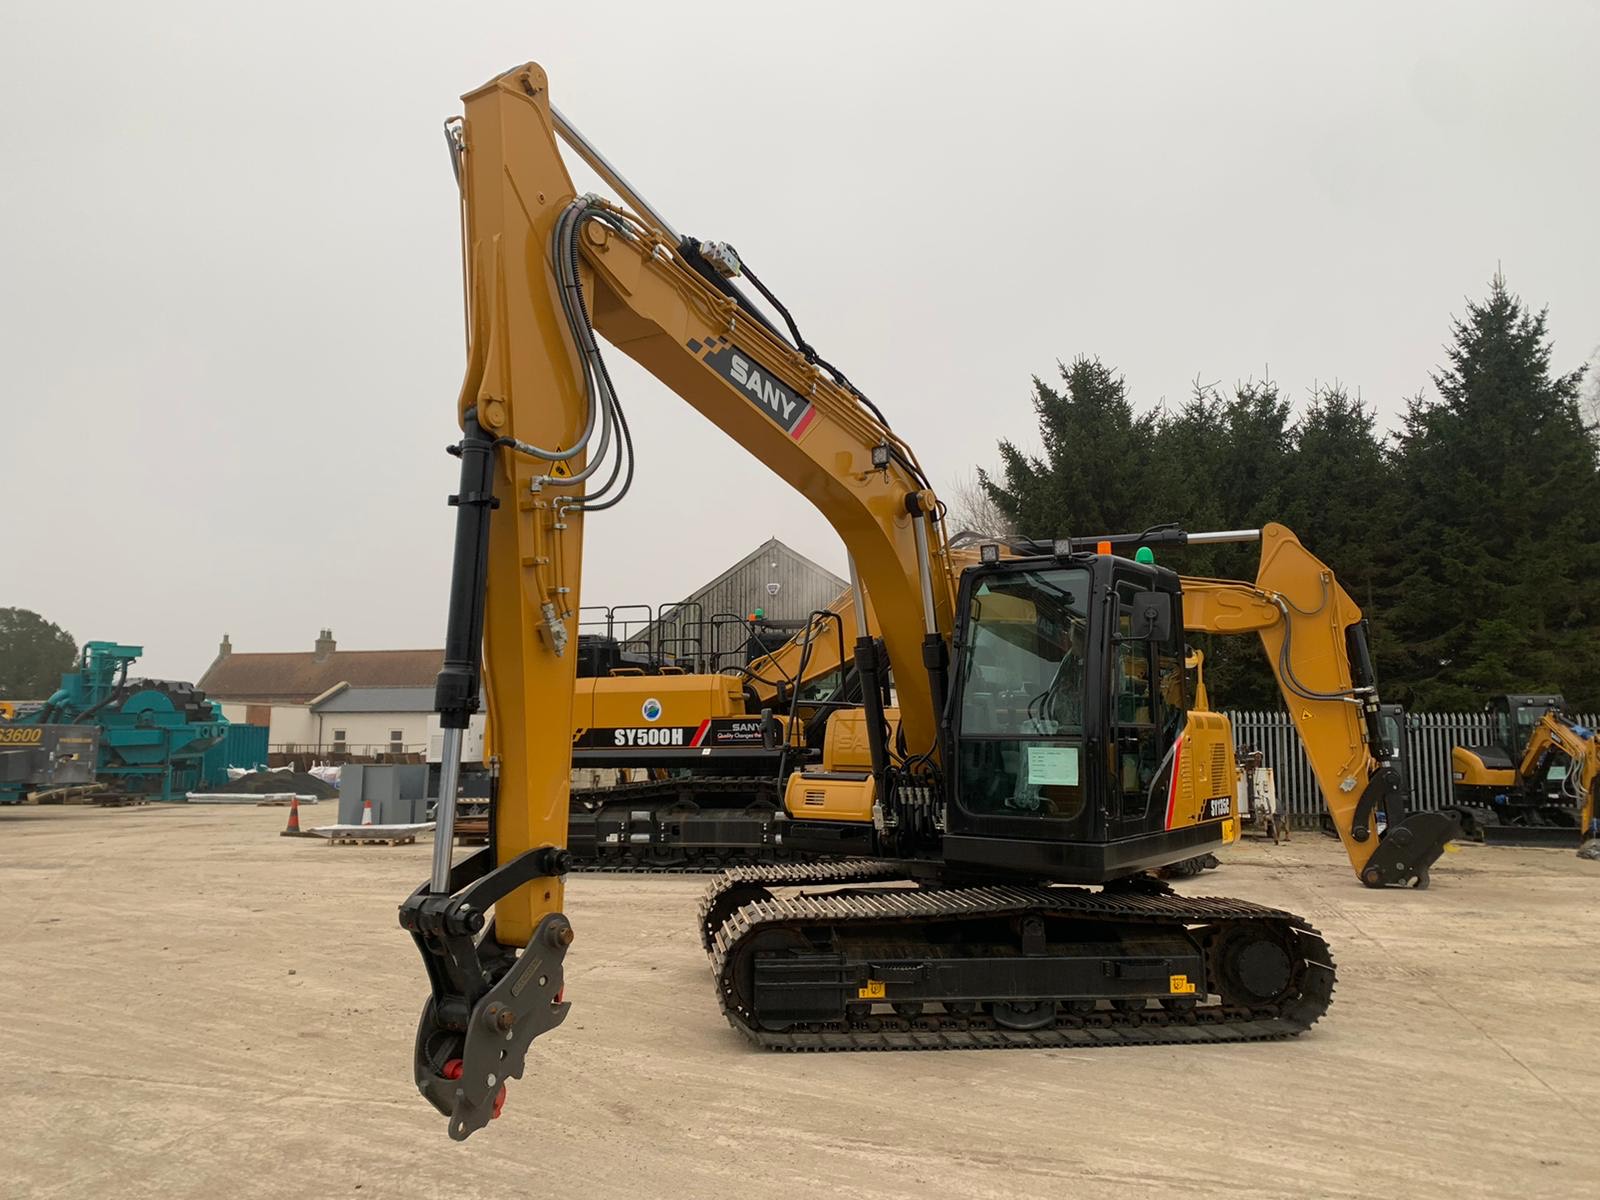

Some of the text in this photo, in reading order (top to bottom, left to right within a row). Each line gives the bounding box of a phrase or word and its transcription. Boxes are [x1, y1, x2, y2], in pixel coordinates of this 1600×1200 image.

[730, 354, 796, 420] SANY
[732, 723, 762, 732] SANY
[614, 728, 683, 746] SY500H
[717, 732, 734, 740] Quality
[734, 732, 753, 740] Changes
